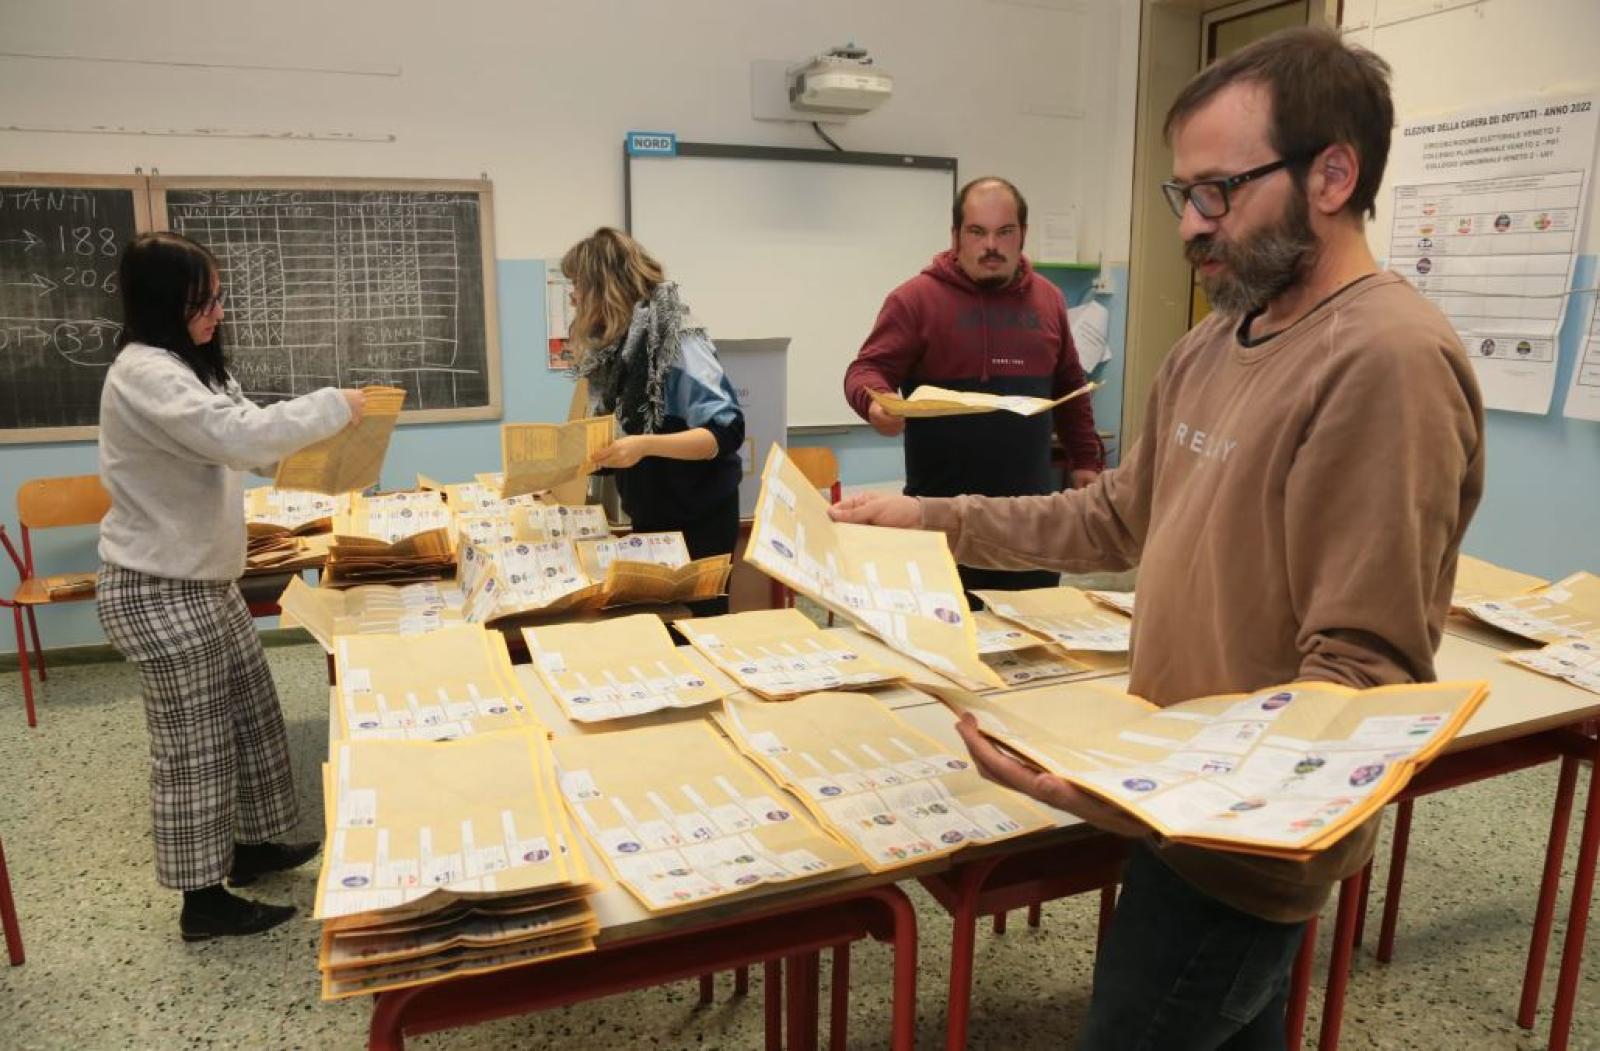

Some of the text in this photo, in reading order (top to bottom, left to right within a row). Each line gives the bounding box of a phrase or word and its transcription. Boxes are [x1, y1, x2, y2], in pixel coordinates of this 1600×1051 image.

[1437, 122, 1460, 132] DELLA
[1501, 109, 1538, 123] DEPUTATI
[1544, 106, 1569, 117] ANNO
[1569, 101, 1593, 112] 2022
[634, 138, 670, 149] NORD
[0, 190, 97, 219] TANTI
[58, 225, 118, 256] 188
[62, 266, 118, 293] 206
